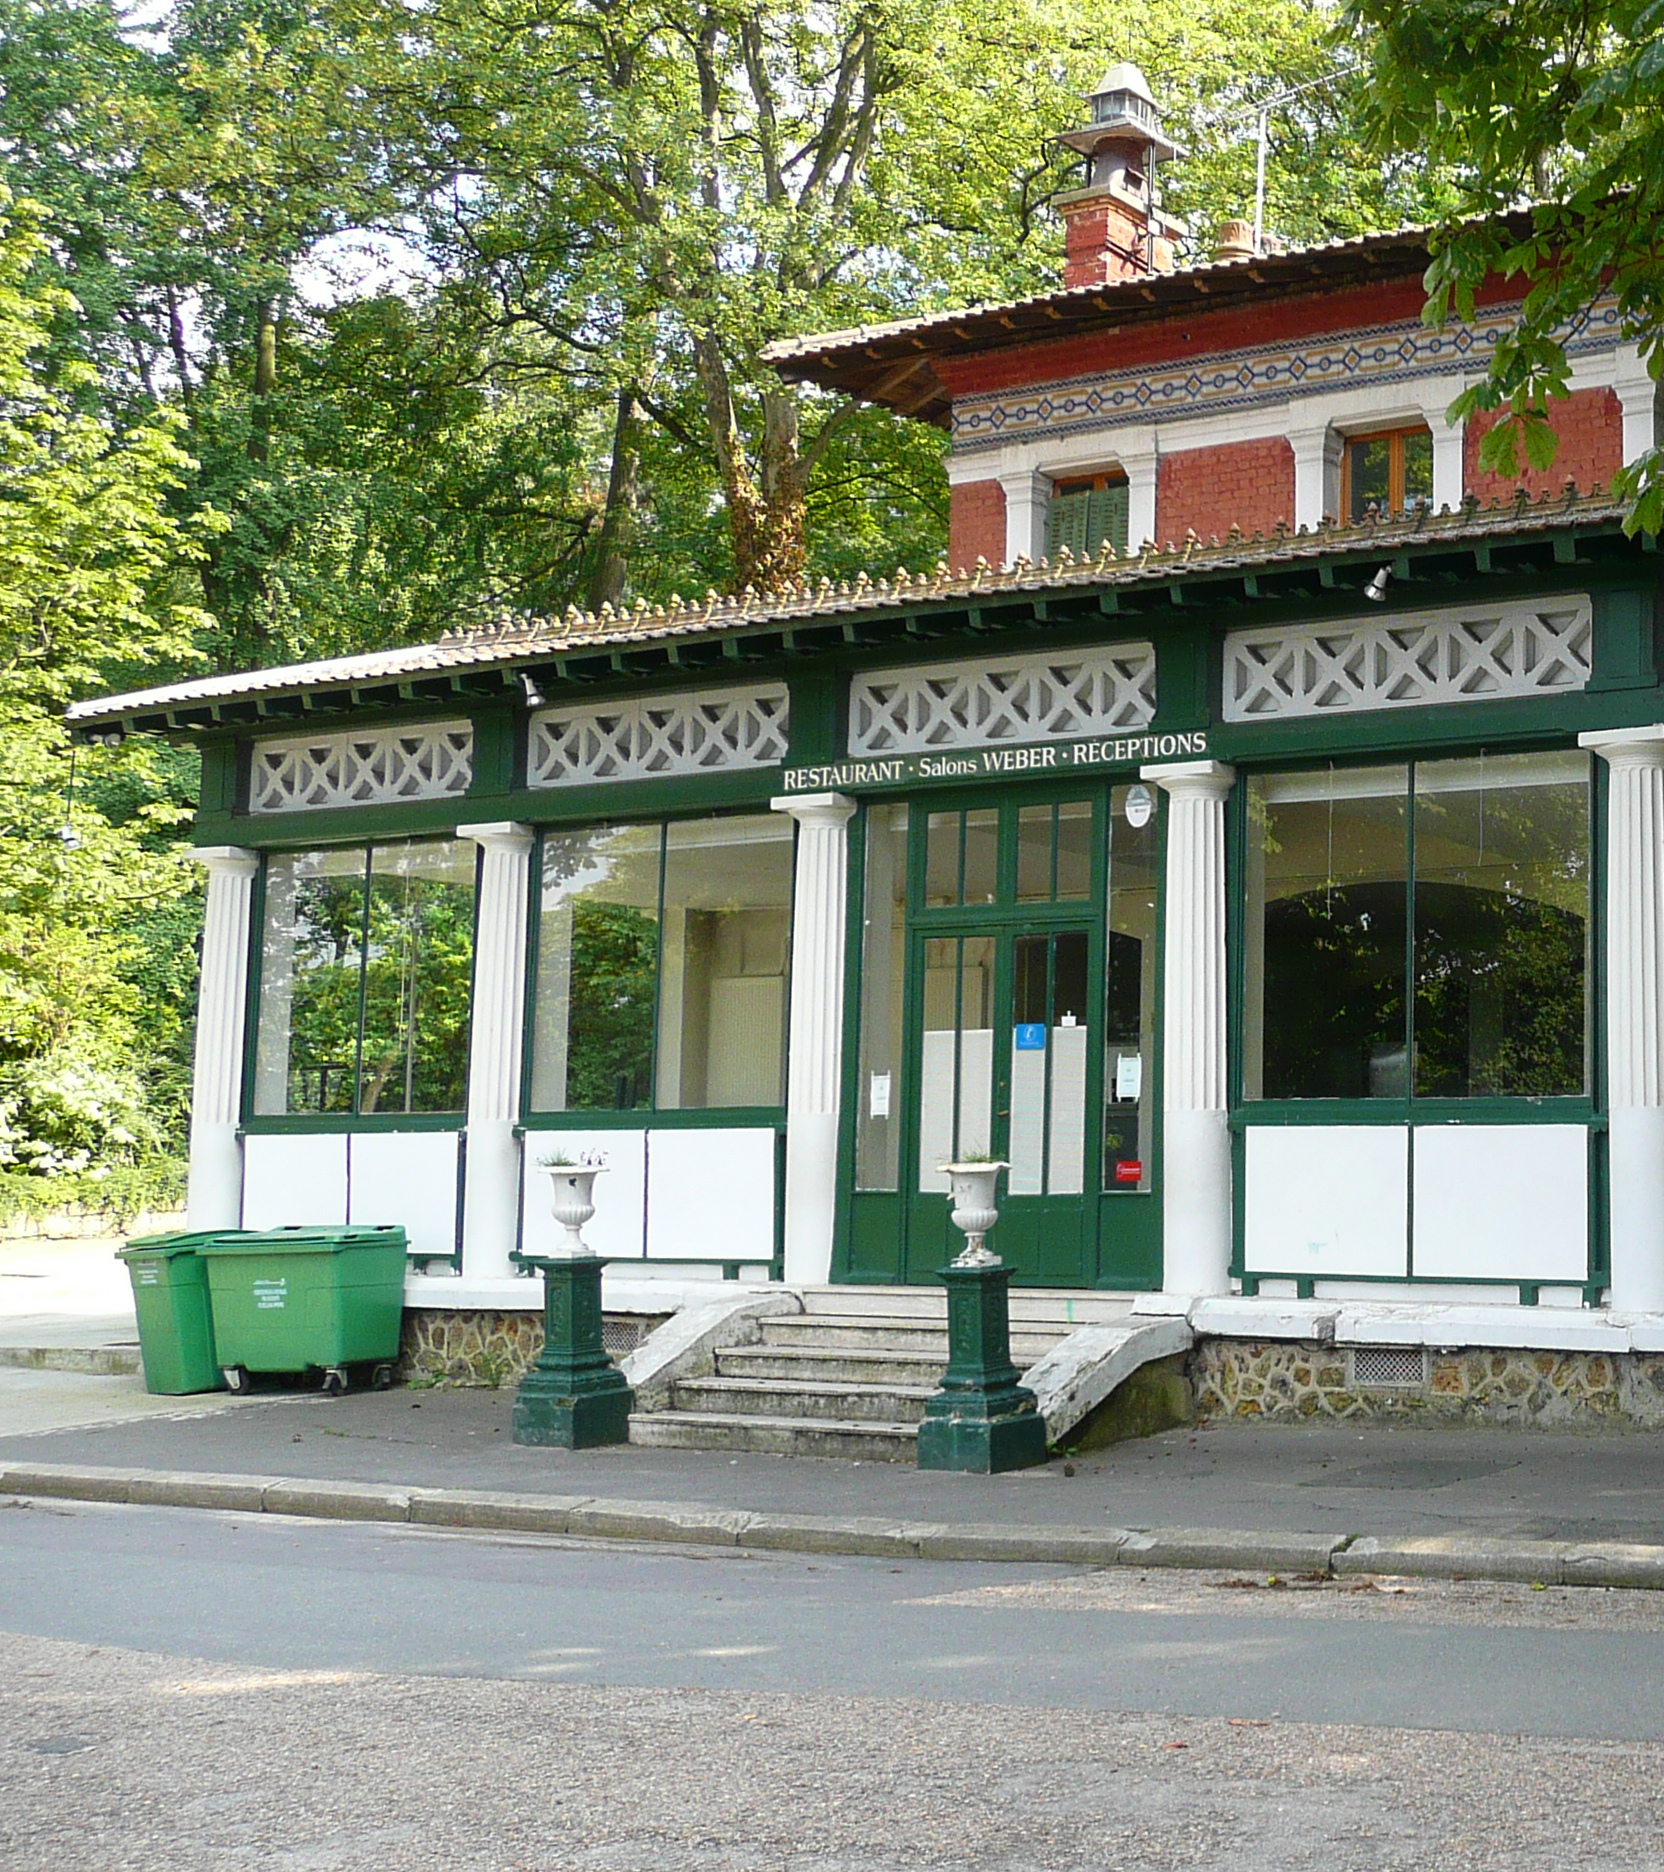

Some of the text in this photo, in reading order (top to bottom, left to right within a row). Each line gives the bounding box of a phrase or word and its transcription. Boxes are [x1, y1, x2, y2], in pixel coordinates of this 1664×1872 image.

[783, 761, 904, 790] RESTAURANT
[918, 757, 977, 777] Salons
[982, 747, 1056, 771] WEBER
